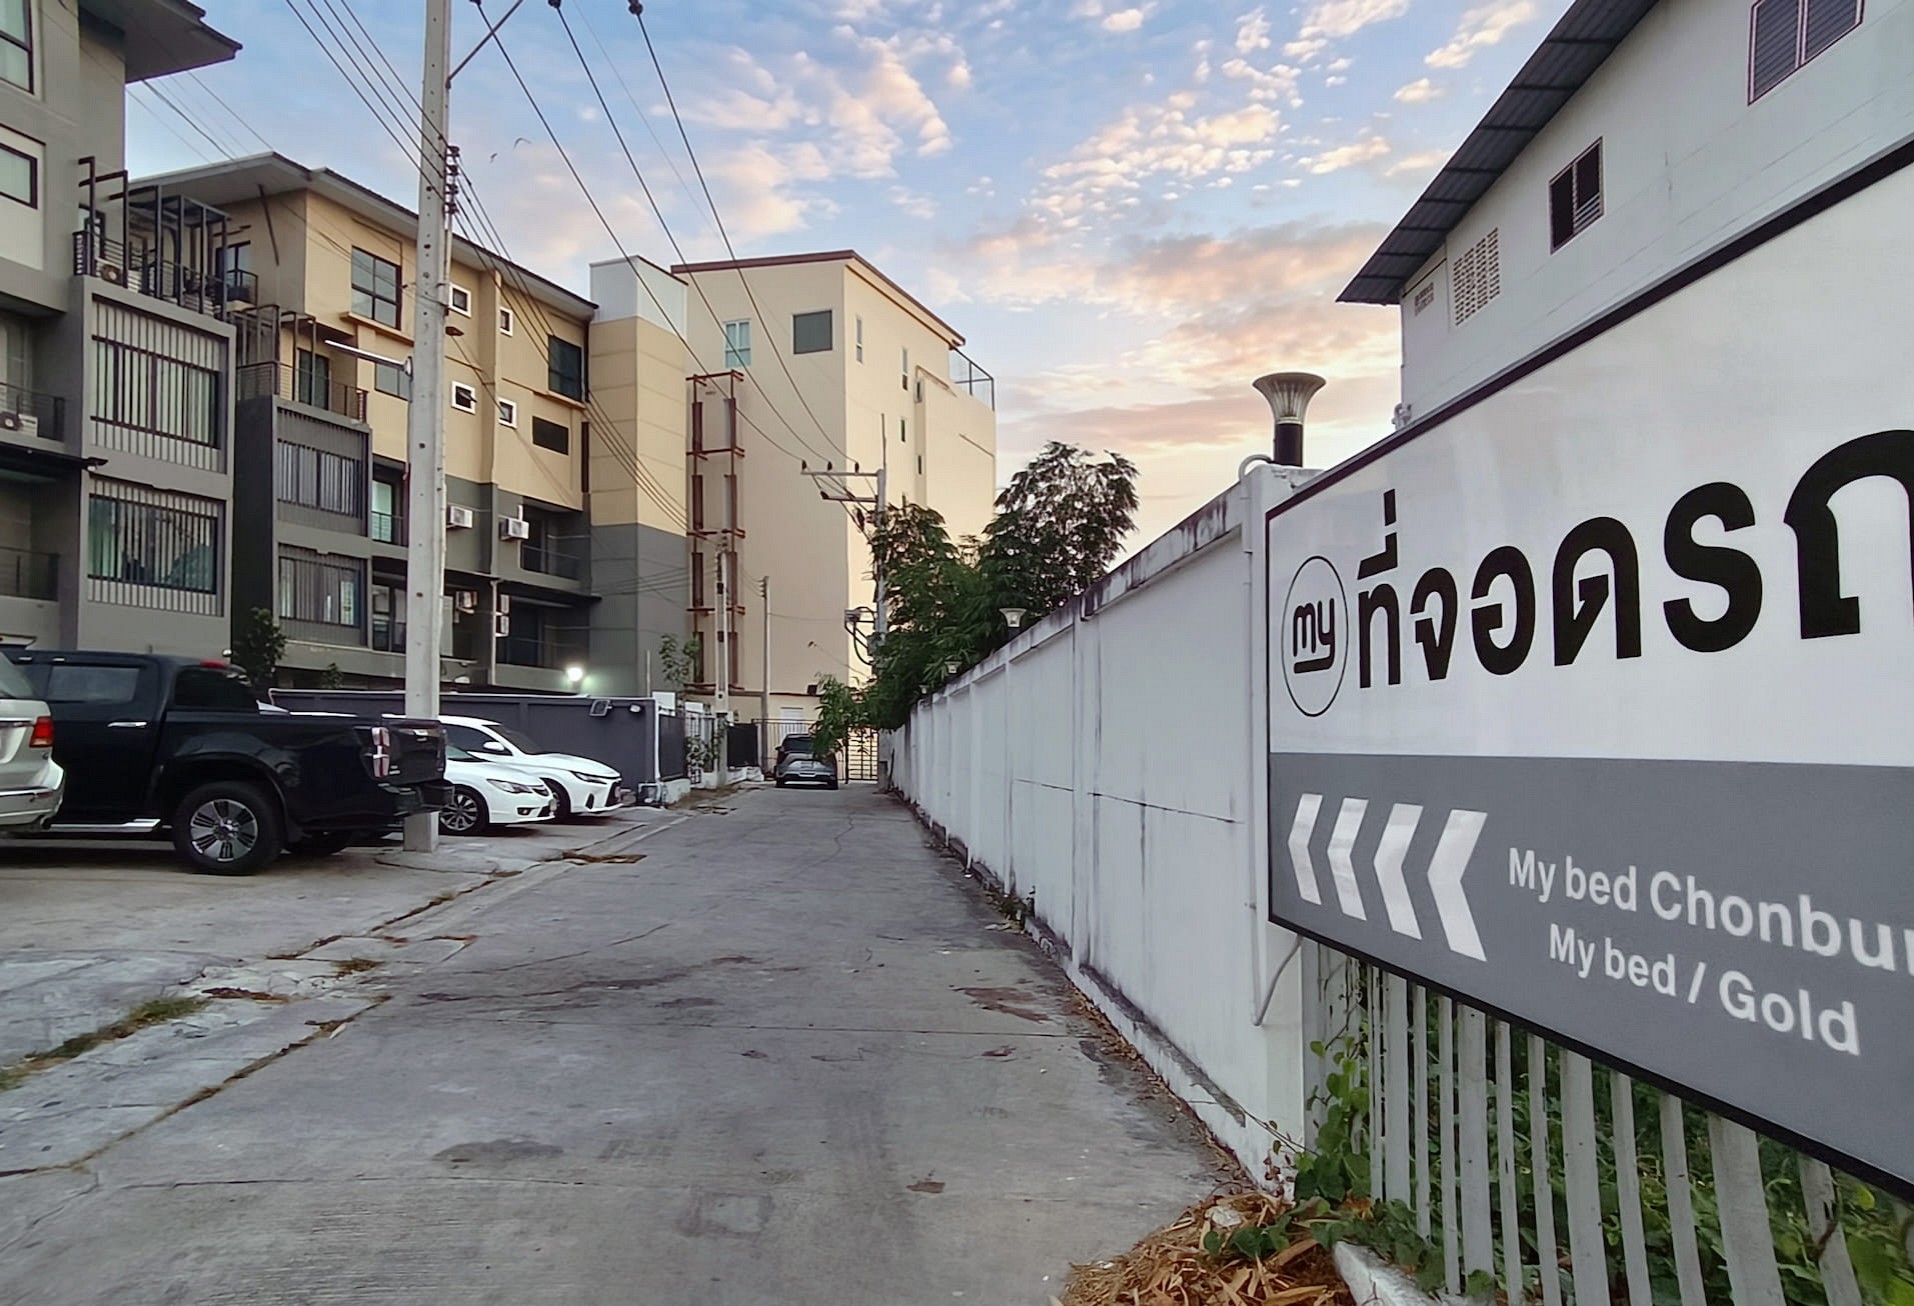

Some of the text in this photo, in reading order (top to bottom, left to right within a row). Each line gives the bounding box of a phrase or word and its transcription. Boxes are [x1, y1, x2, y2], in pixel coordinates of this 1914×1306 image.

[1293, 597, 1335, 674] my
[1509, 847, 1556, 903] My
[1566, 855, 1637, 912] bed
[1549, 923, 1861, 1056] My bed / Gold
